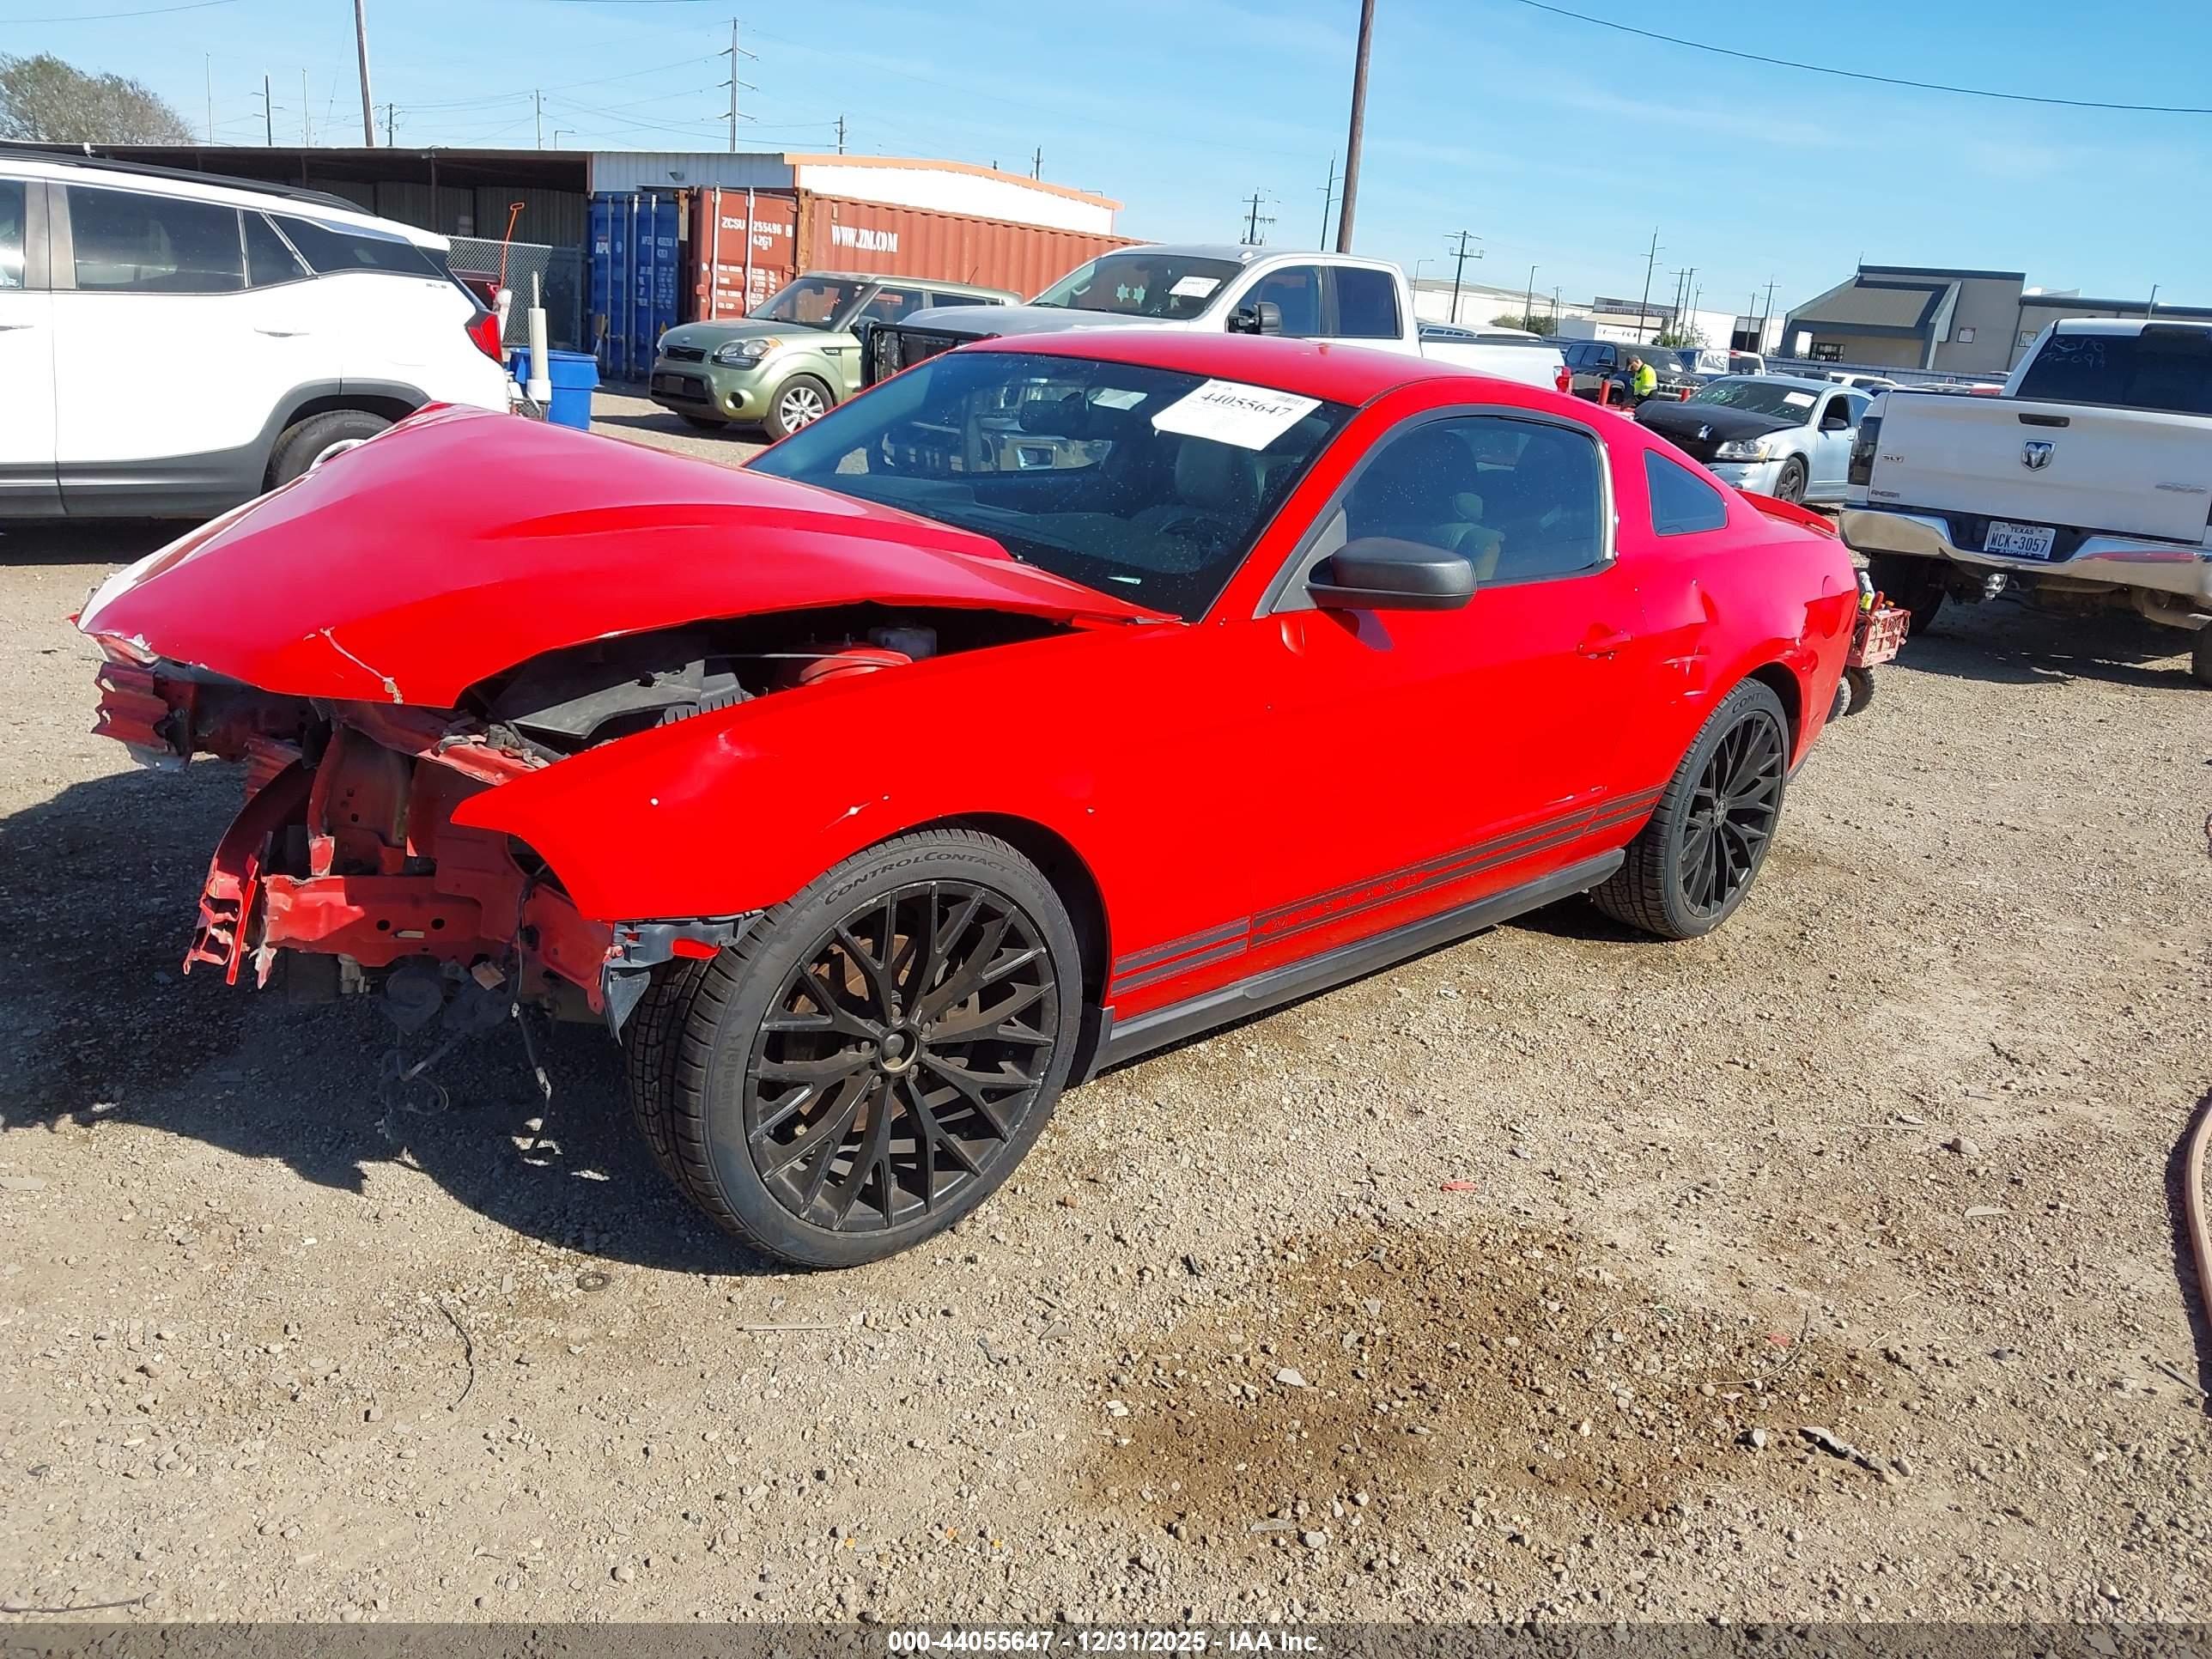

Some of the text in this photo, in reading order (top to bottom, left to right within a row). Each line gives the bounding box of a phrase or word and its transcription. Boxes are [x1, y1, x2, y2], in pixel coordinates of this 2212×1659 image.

[721, 216, 746, 230] ZCSU
[831, 224, 899, 252] WWW.ZIM.COM
[1201, 392, 1293, 416] 44055647
[2010, 526, 2034, 535] TEXAS
